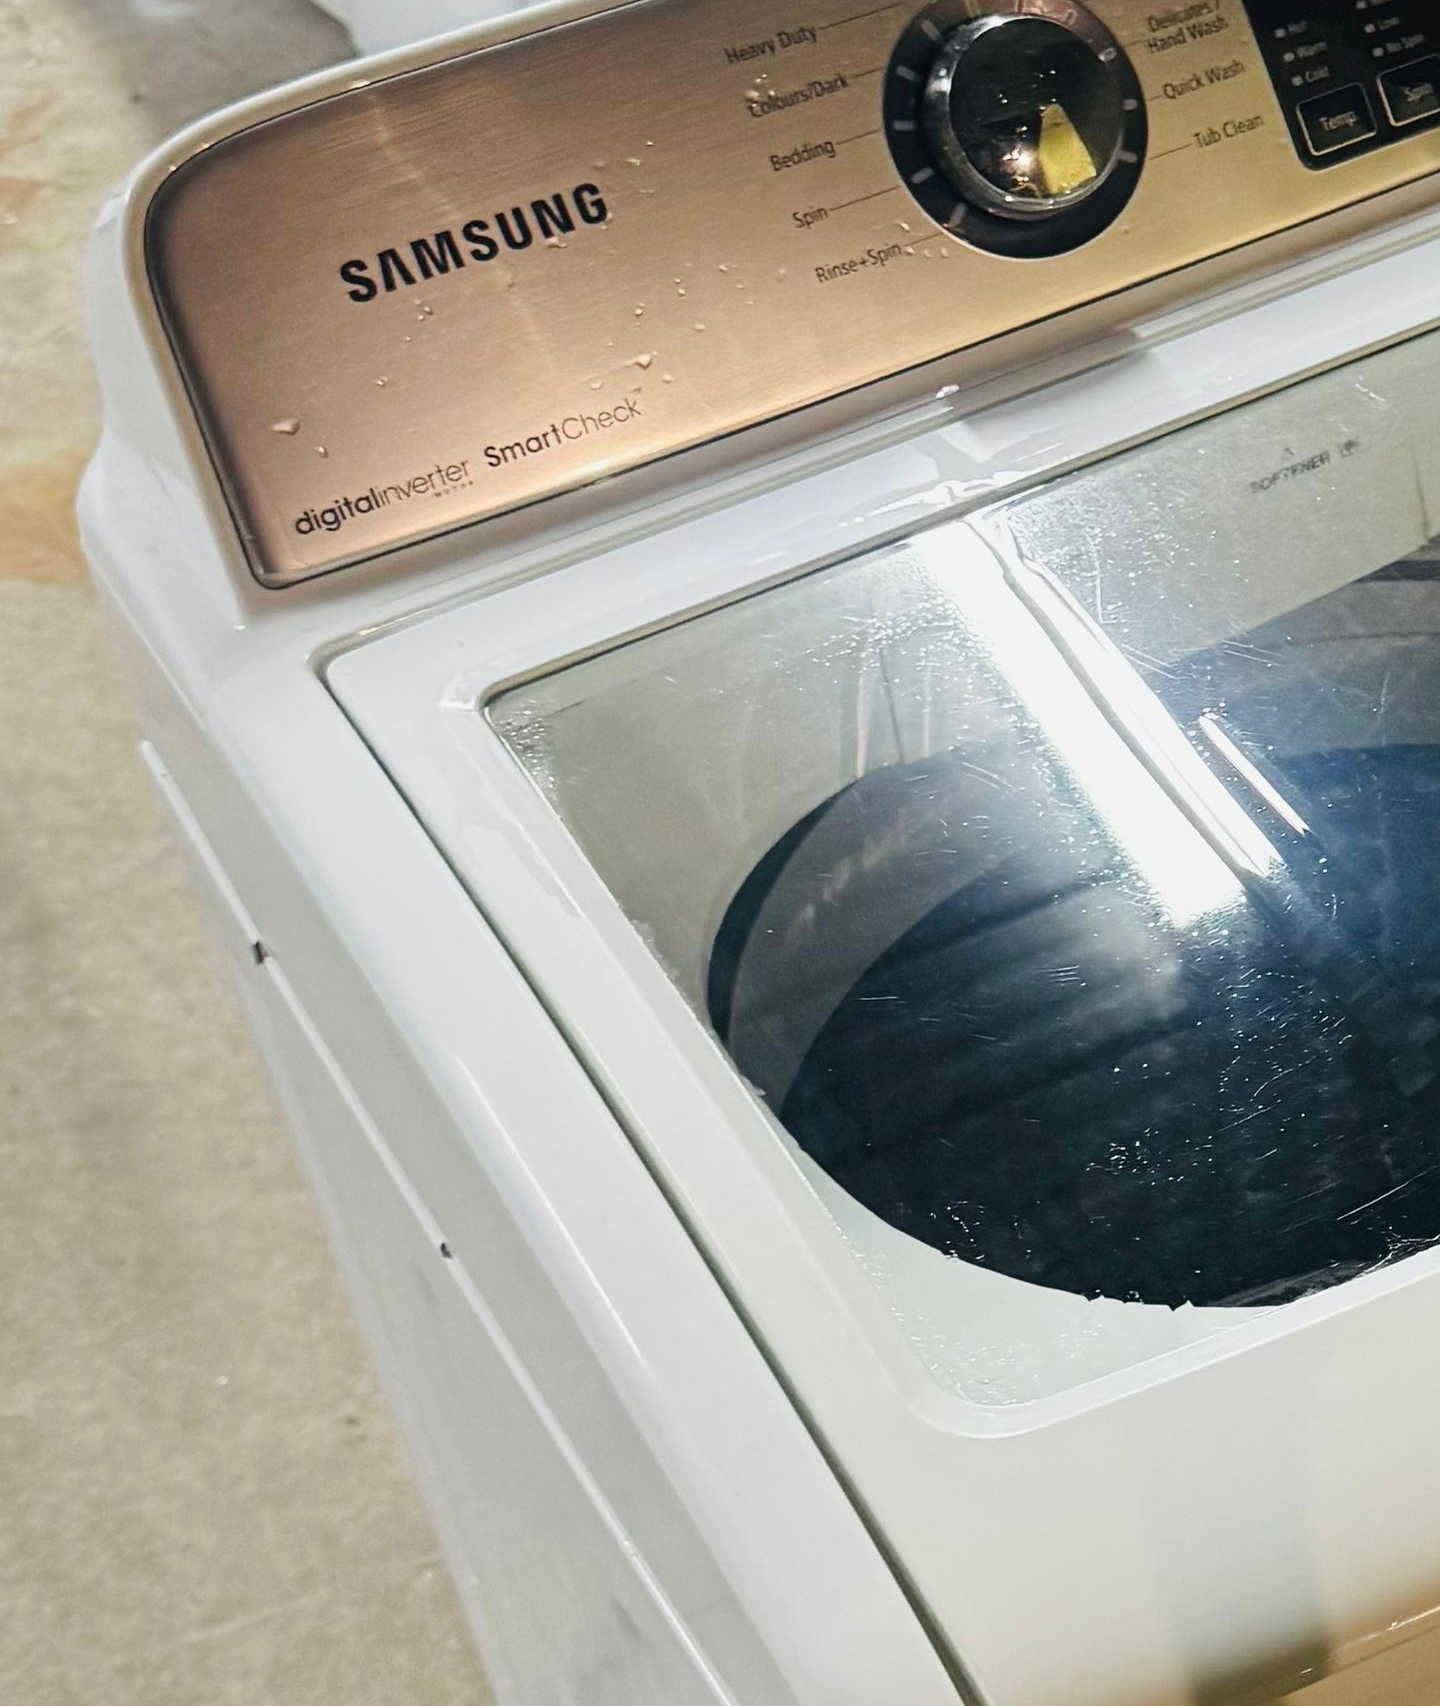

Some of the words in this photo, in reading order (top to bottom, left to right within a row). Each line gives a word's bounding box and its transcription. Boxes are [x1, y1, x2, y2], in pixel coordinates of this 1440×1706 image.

[724, 41, 777, 65] Heavy
[776, 26, 818, 49] Duty
[1147, 26, 1187, 54] Hand
[1186, 15, 1230, 40] Wash
[747, 74, 850, 118] Colours/Dark
[1162, 72, 1205, 100] Quick
[1203, 59, 1246, 84] Wash
[1193, 127, 1222, 149] Tub
[1222, 115, 1265, 138] Clean
[770, 141, 837, 172] Bedding
[792, 206, 830, 230] Spin
[339, 183, 608, 303] SAMSUNG
[814, 243, 903, 283] Rinse+Spin
[294, 458, 471, 536] digitalinverter
[483, 397, 643, 469] SmartCheck
